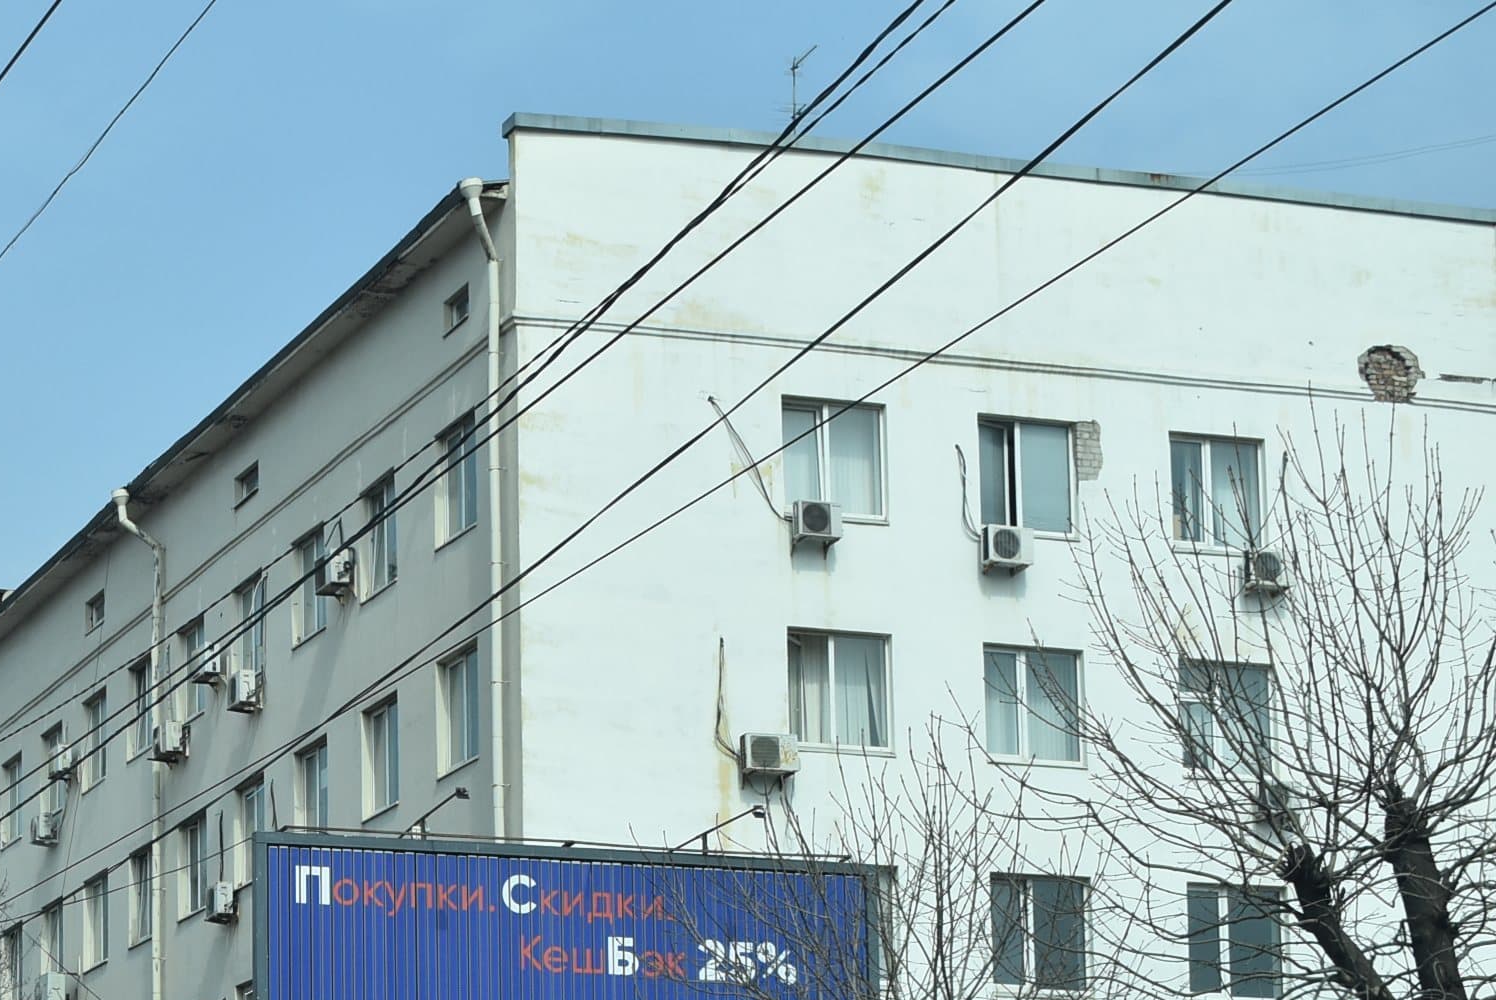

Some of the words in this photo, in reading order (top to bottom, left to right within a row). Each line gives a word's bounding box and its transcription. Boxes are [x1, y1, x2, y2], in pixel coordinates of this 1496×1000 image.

[295, 865, 496, 917] Покупки.
[502, 874, 677, 924] Скидки.
[520, 935, 688, 977] КешБэк
[697, 938, 798, 985] 25%
